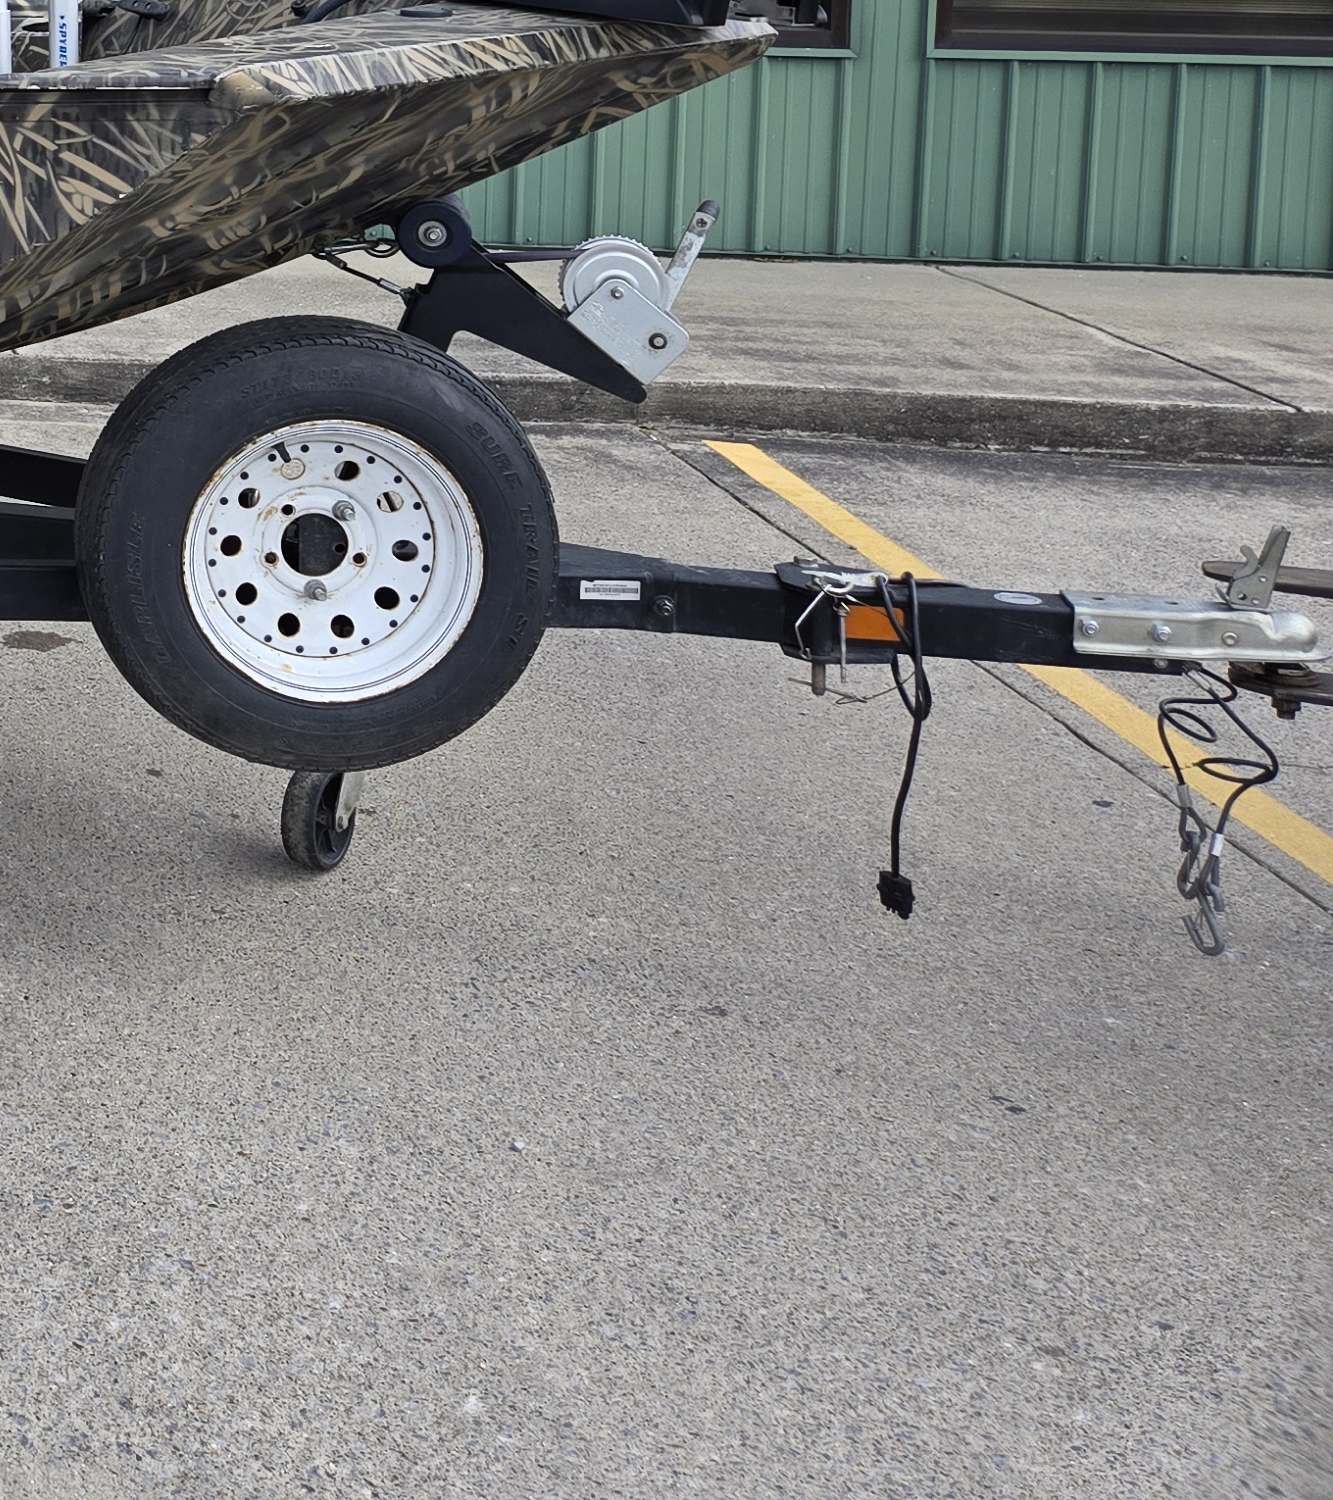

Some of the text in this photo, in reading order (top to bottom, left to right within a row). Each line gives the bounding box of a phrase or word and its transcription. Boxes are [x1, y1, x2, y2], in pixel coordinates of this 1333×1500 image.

[126, 512, 174, 665] CARLISLE
[465, 421, 524, 492] SURE
[517, 502, 540, 598] TRAIL
